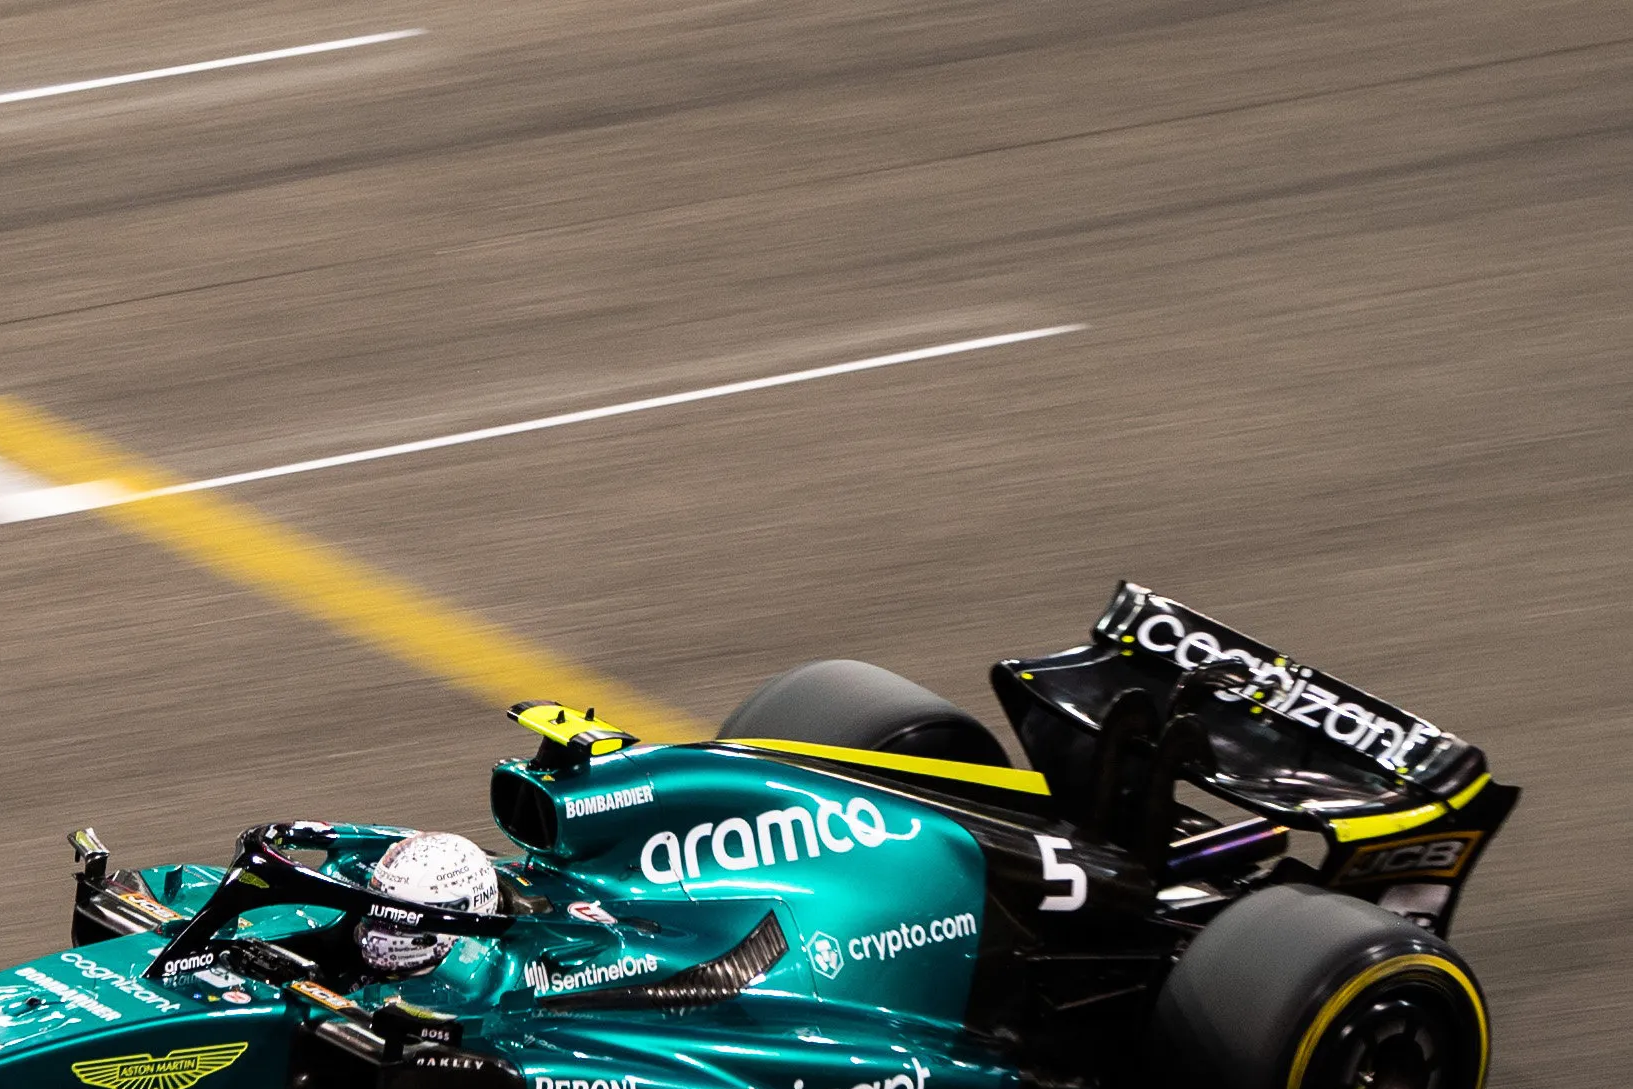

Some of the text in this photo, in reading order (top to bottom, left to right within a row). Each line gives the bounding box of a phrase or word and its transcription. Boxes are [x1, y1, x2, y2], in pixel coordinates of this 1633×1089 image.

[566, 784, 654, 819] BOMBARDIER
[641, 797, 921, 885] aramco
[436, 865, 470, 882] aramco
[1039, 834, 1088, 912] 5
[849, 912, 977, 962] crypto.com
[164, 953, 214, 972] aramco
[551, 955, 658, 993] SentinelOne
[421, 1028, 450, 1041] BOSS
[121, 1059, 196, 1076] ASTON MARTIN
